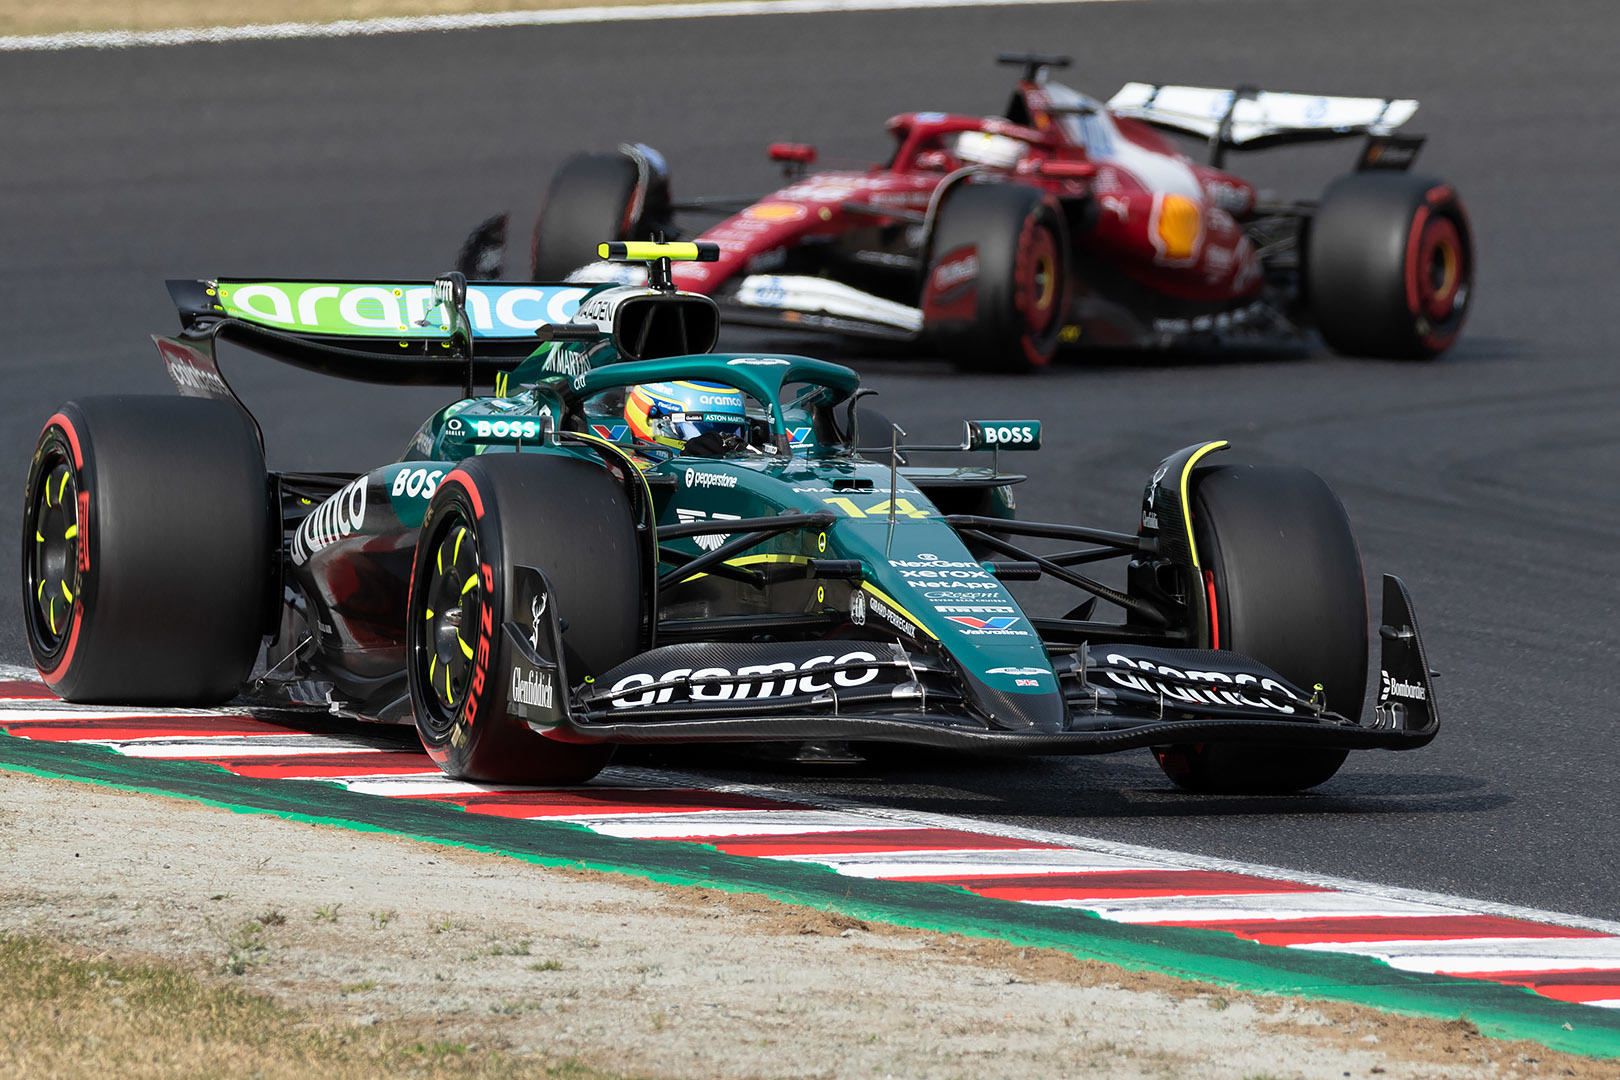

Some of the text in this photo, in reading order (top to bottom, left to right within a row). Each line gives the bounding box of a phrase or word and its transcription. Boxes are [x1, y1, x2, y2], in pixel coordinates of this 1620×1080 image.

[705, 414, 727, 422] ASTON
[477, 420, 536, 438] BOSS
[984, 427, 1034, 443] BOSS
[392, 468, 447, 500] BOS
[694, 471, 738, 488] pepperstone
[822, 497, 931, 519] 14
[888, 559, 980, 568] NexGen
[900, 570, 990, 579] xerox
[906, 580, 998, 589] NetApp
[923, 591, 999, 600] Regent
[934, 605, 1015, 613] PIRELLI
[959, 629, 1029, 637] Valvoline
[464, 562, 493, 727] P ZERO
[512, 666, 553, 709] Glenfiddich
[610, 651, 880, 709] aramco
[1105, 653, 1298, 715] aramco
